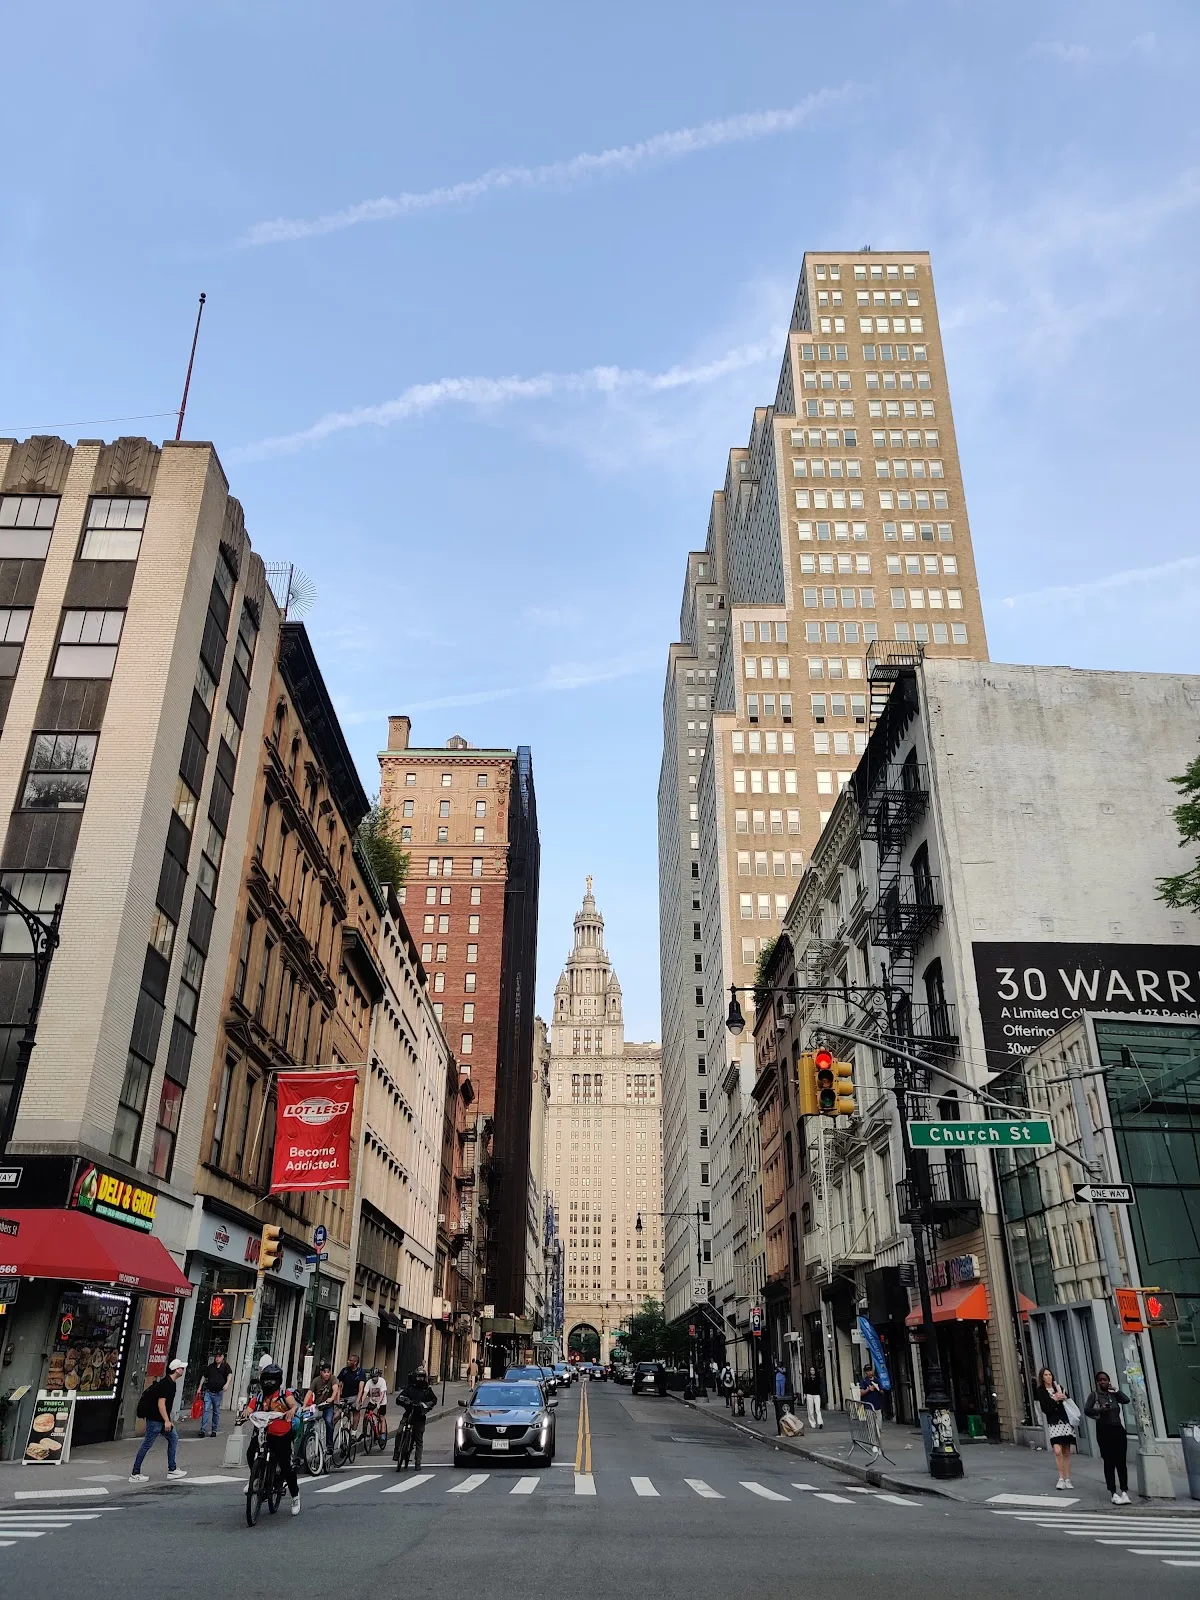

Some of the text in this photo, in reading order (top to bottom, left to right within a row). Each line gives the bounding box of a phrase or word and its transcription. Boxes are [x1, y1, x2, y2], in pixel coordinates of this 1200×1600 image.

[995, 967, 1200, 1002] 30 WARR
[1001, 1007, 1011, 1018] A
[1013, 1007, 1059, 1019] Limited
[1162, 1008, 1200, 1019] Resid
[287, 1103, 347, 1115] LOT-LESS
[929, 1126, 1031, 1141] Church St
[289, 1146, 336, 1157] Become
[285, 1158, 340, 1171] Addicted.
[97, 1174, 125, 1207] DELI
[122, 1184, 132, 1210] &
[132, 1188, 158, 1219] GRILL
[1109, 1190, 1125, 1198] WAY
[159, 1300, 175, 1312] STORE
[1118, 1296, 1140, 1311] DETOUR
[159, 1313, 169, 1324] FOR
[156, 1326, 169, 1337] RENT
[154, 1344, 165, 1353] CALL
